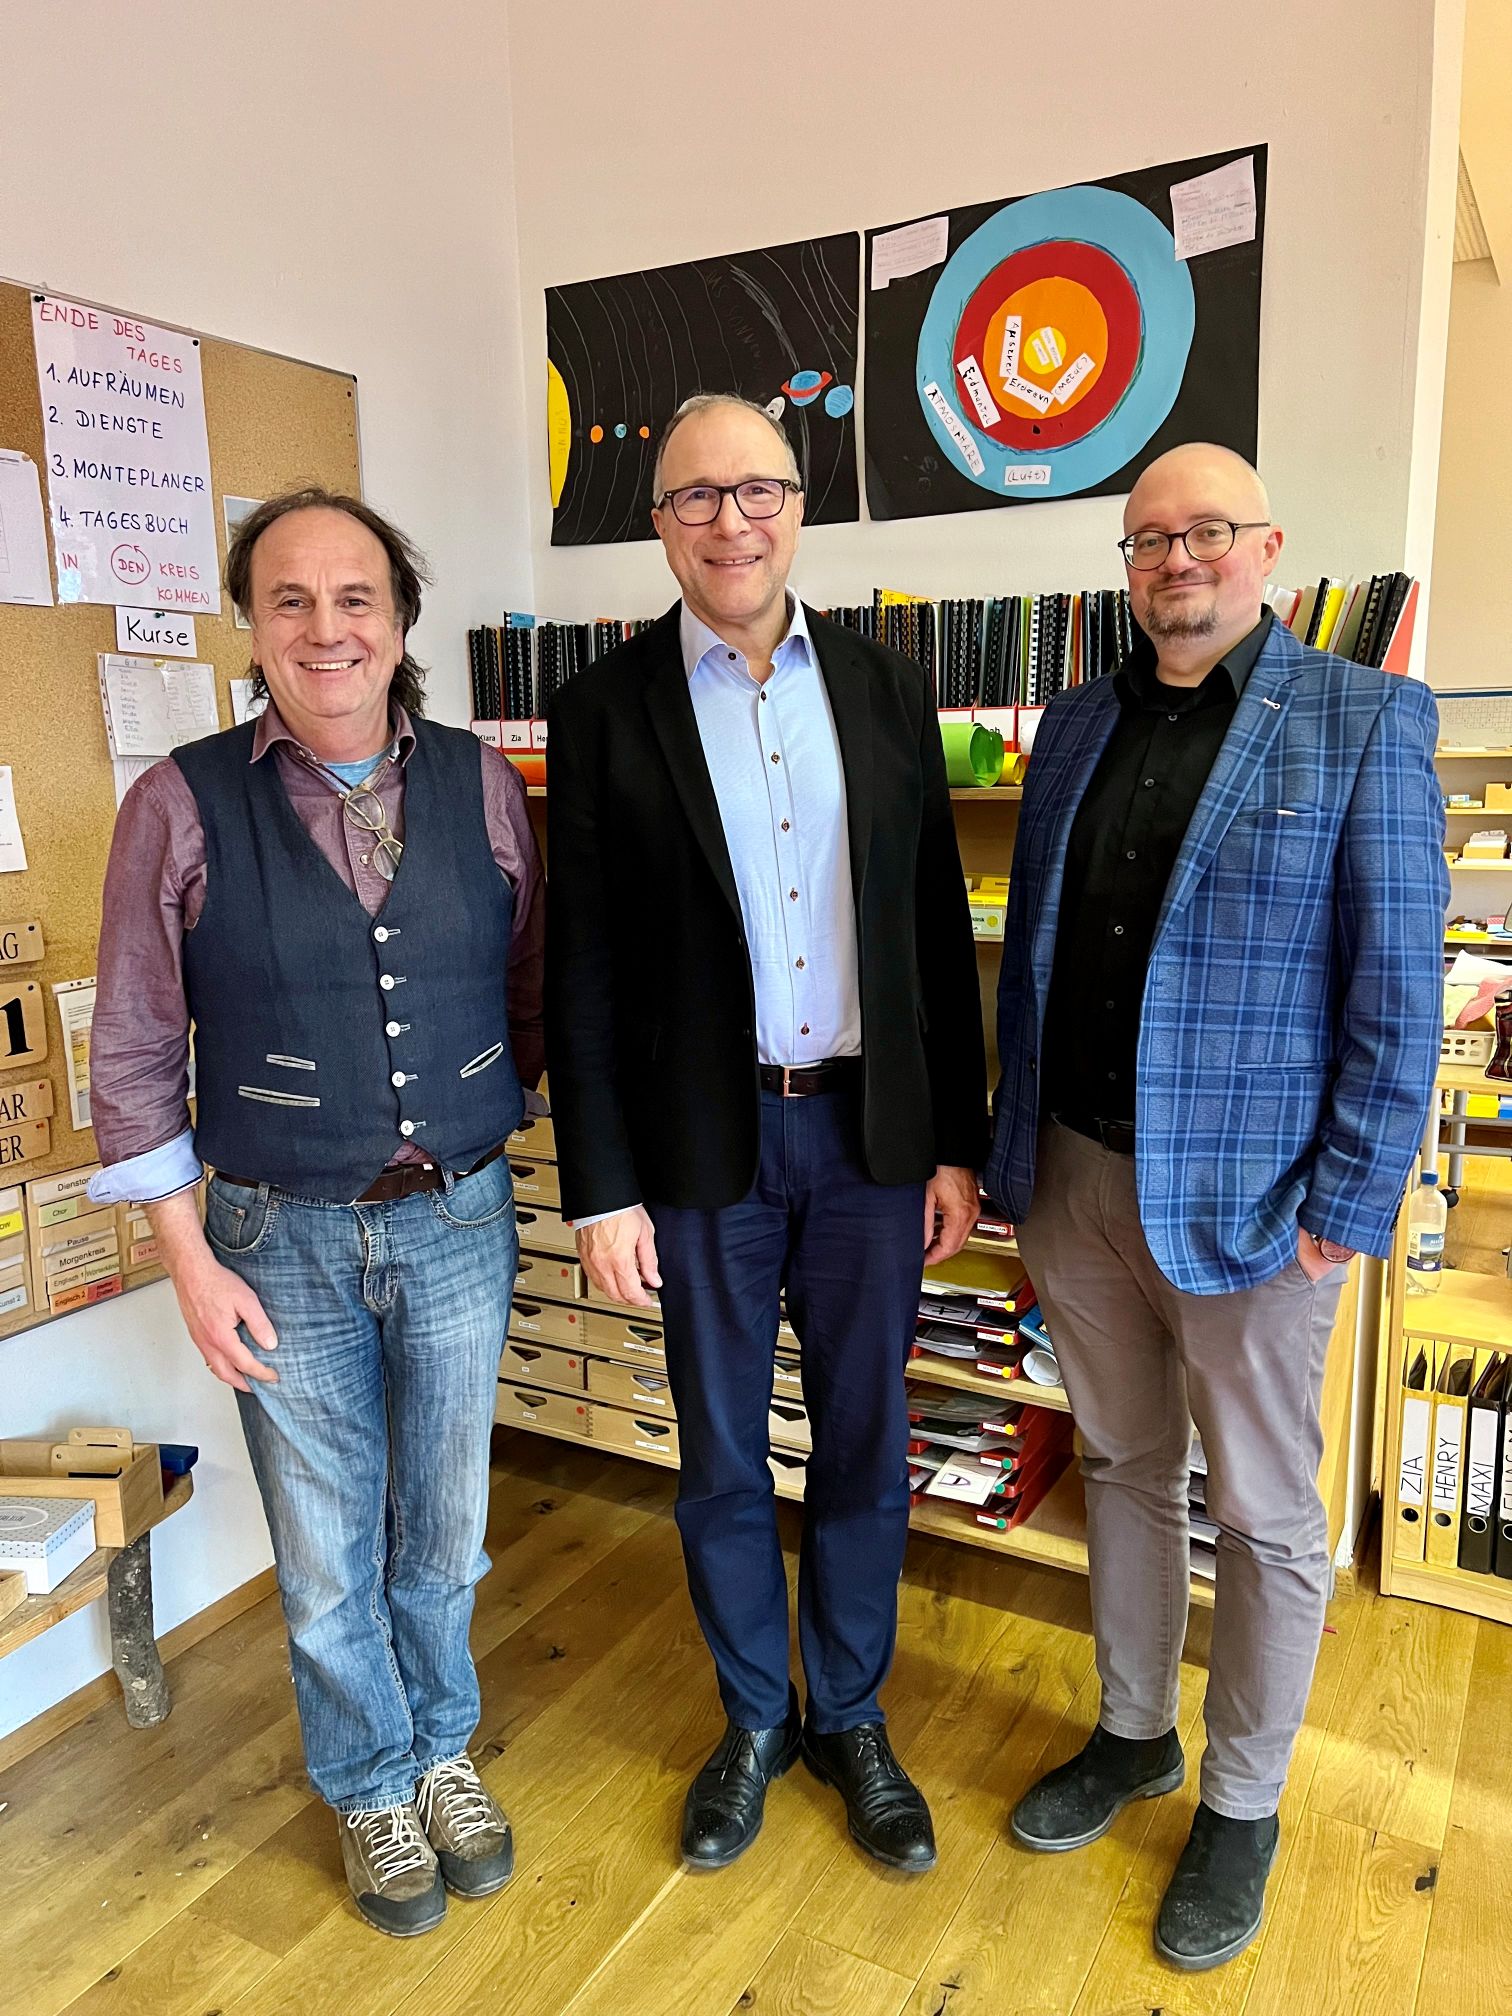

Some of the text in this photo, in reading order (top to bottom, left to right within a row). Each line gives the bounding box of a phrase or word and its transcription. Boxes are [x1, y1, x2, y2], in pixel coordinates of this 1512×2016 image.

[40, 302, 146, 342] ENDE DES
[126, 346, 183, 374] TAGES
[46, 362, 185, 409] 1. AUFRÄUMEN
[48, 405, 164, 439] 2. DIENSTE
[51, 453, 206, 493] 3. MONTEPLANER
[59, 505, 74, 528] 4.
[62, 552, 201, 581] IN DEN KREIS
[156, 586, 210, 605] KOMMEN
[126, 615, 190, 647] Kurse
[511, 733, 522, 742] Zia
[66, 1234, 90, 1247] Pause
[59, 1246, 106, 1268] Morgenkreis
[54, 1292, 81, 1308] Englisch
[1401, 1455, 1423, 1495] ZIA
[1434, 1437, 1459, 1500] HENRY
[1470, 1461, 1494, 1514] MAXI
